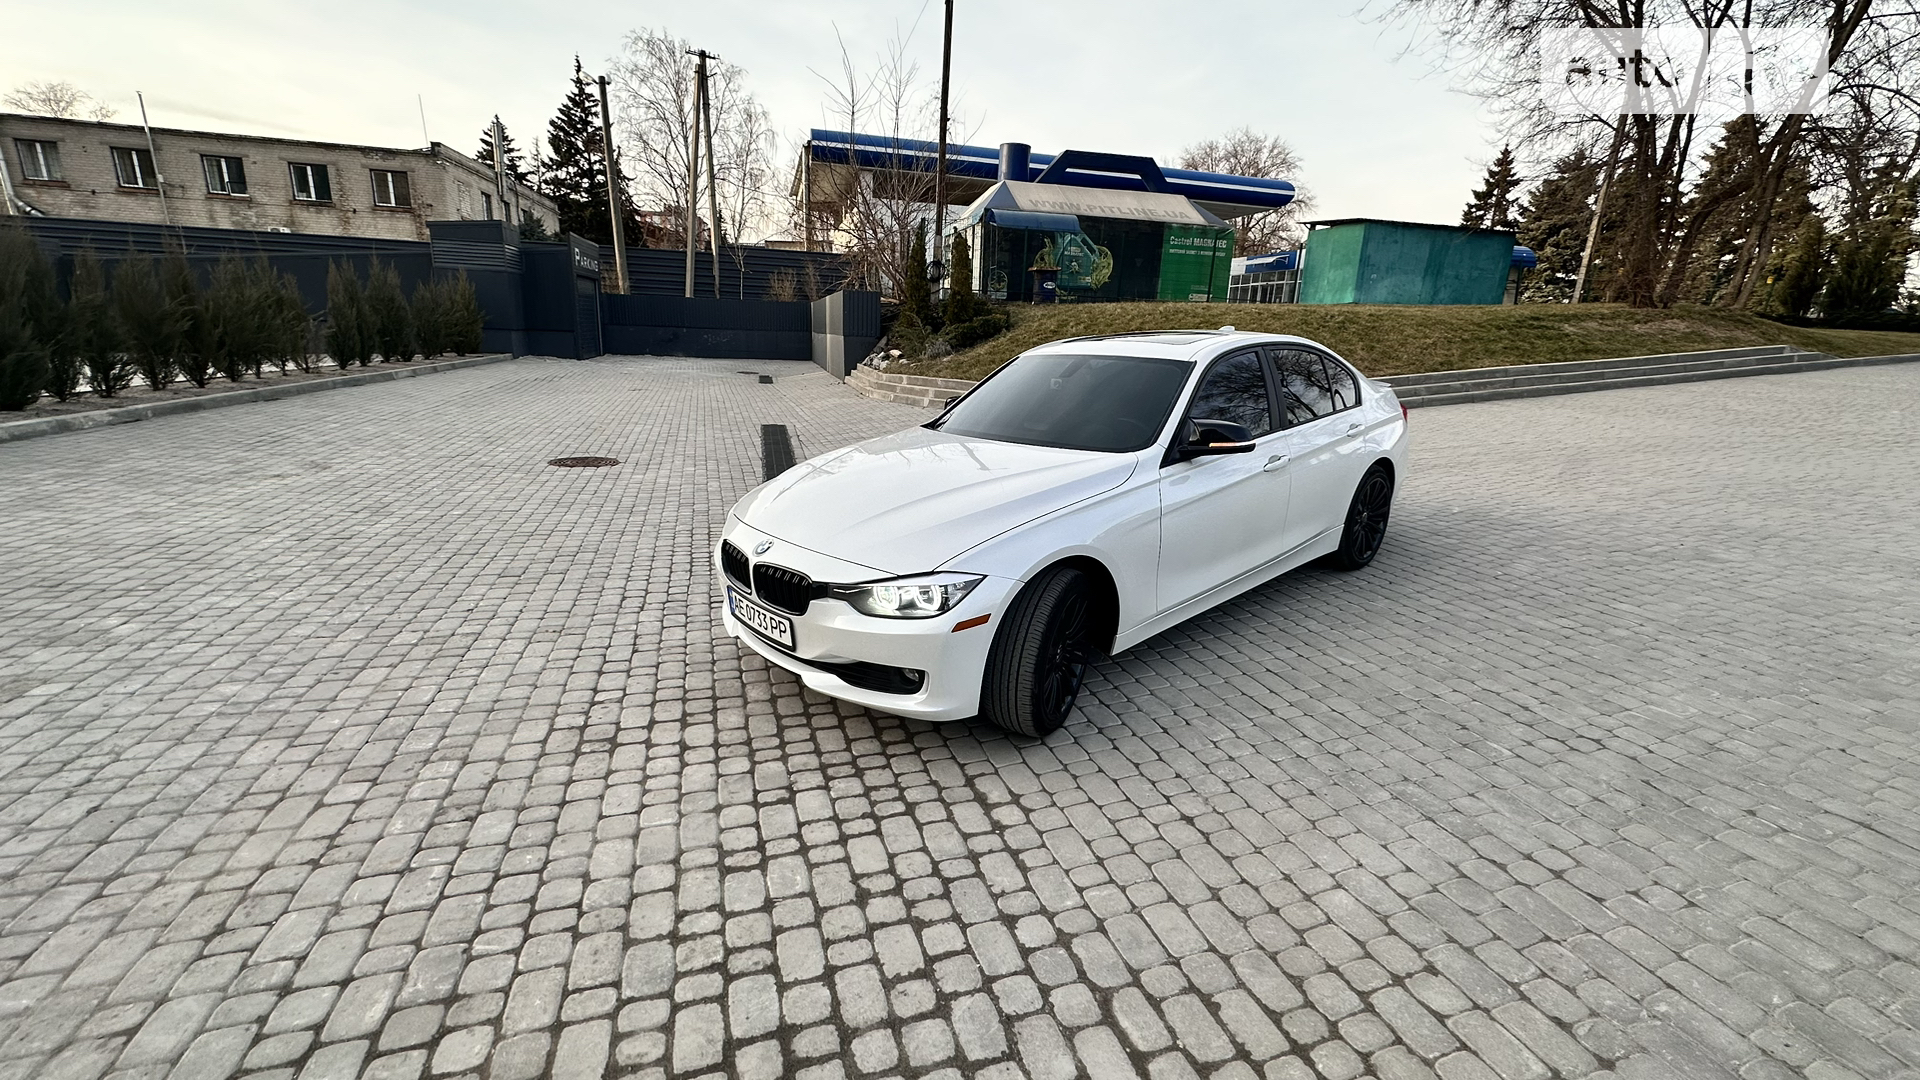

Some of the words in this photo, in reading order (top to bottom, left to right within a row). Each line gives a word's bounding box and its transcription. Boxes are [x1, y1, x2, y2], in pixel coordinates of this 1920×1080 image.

[1029, 199, 1191, 219] WWW.PITLINE.UA
[1169, 235, 1192, 246] Castrol
[734, 595, 746, 618] AE
[745, 604, 768, 630] 0733
[769, 616, 787, 638] PP
